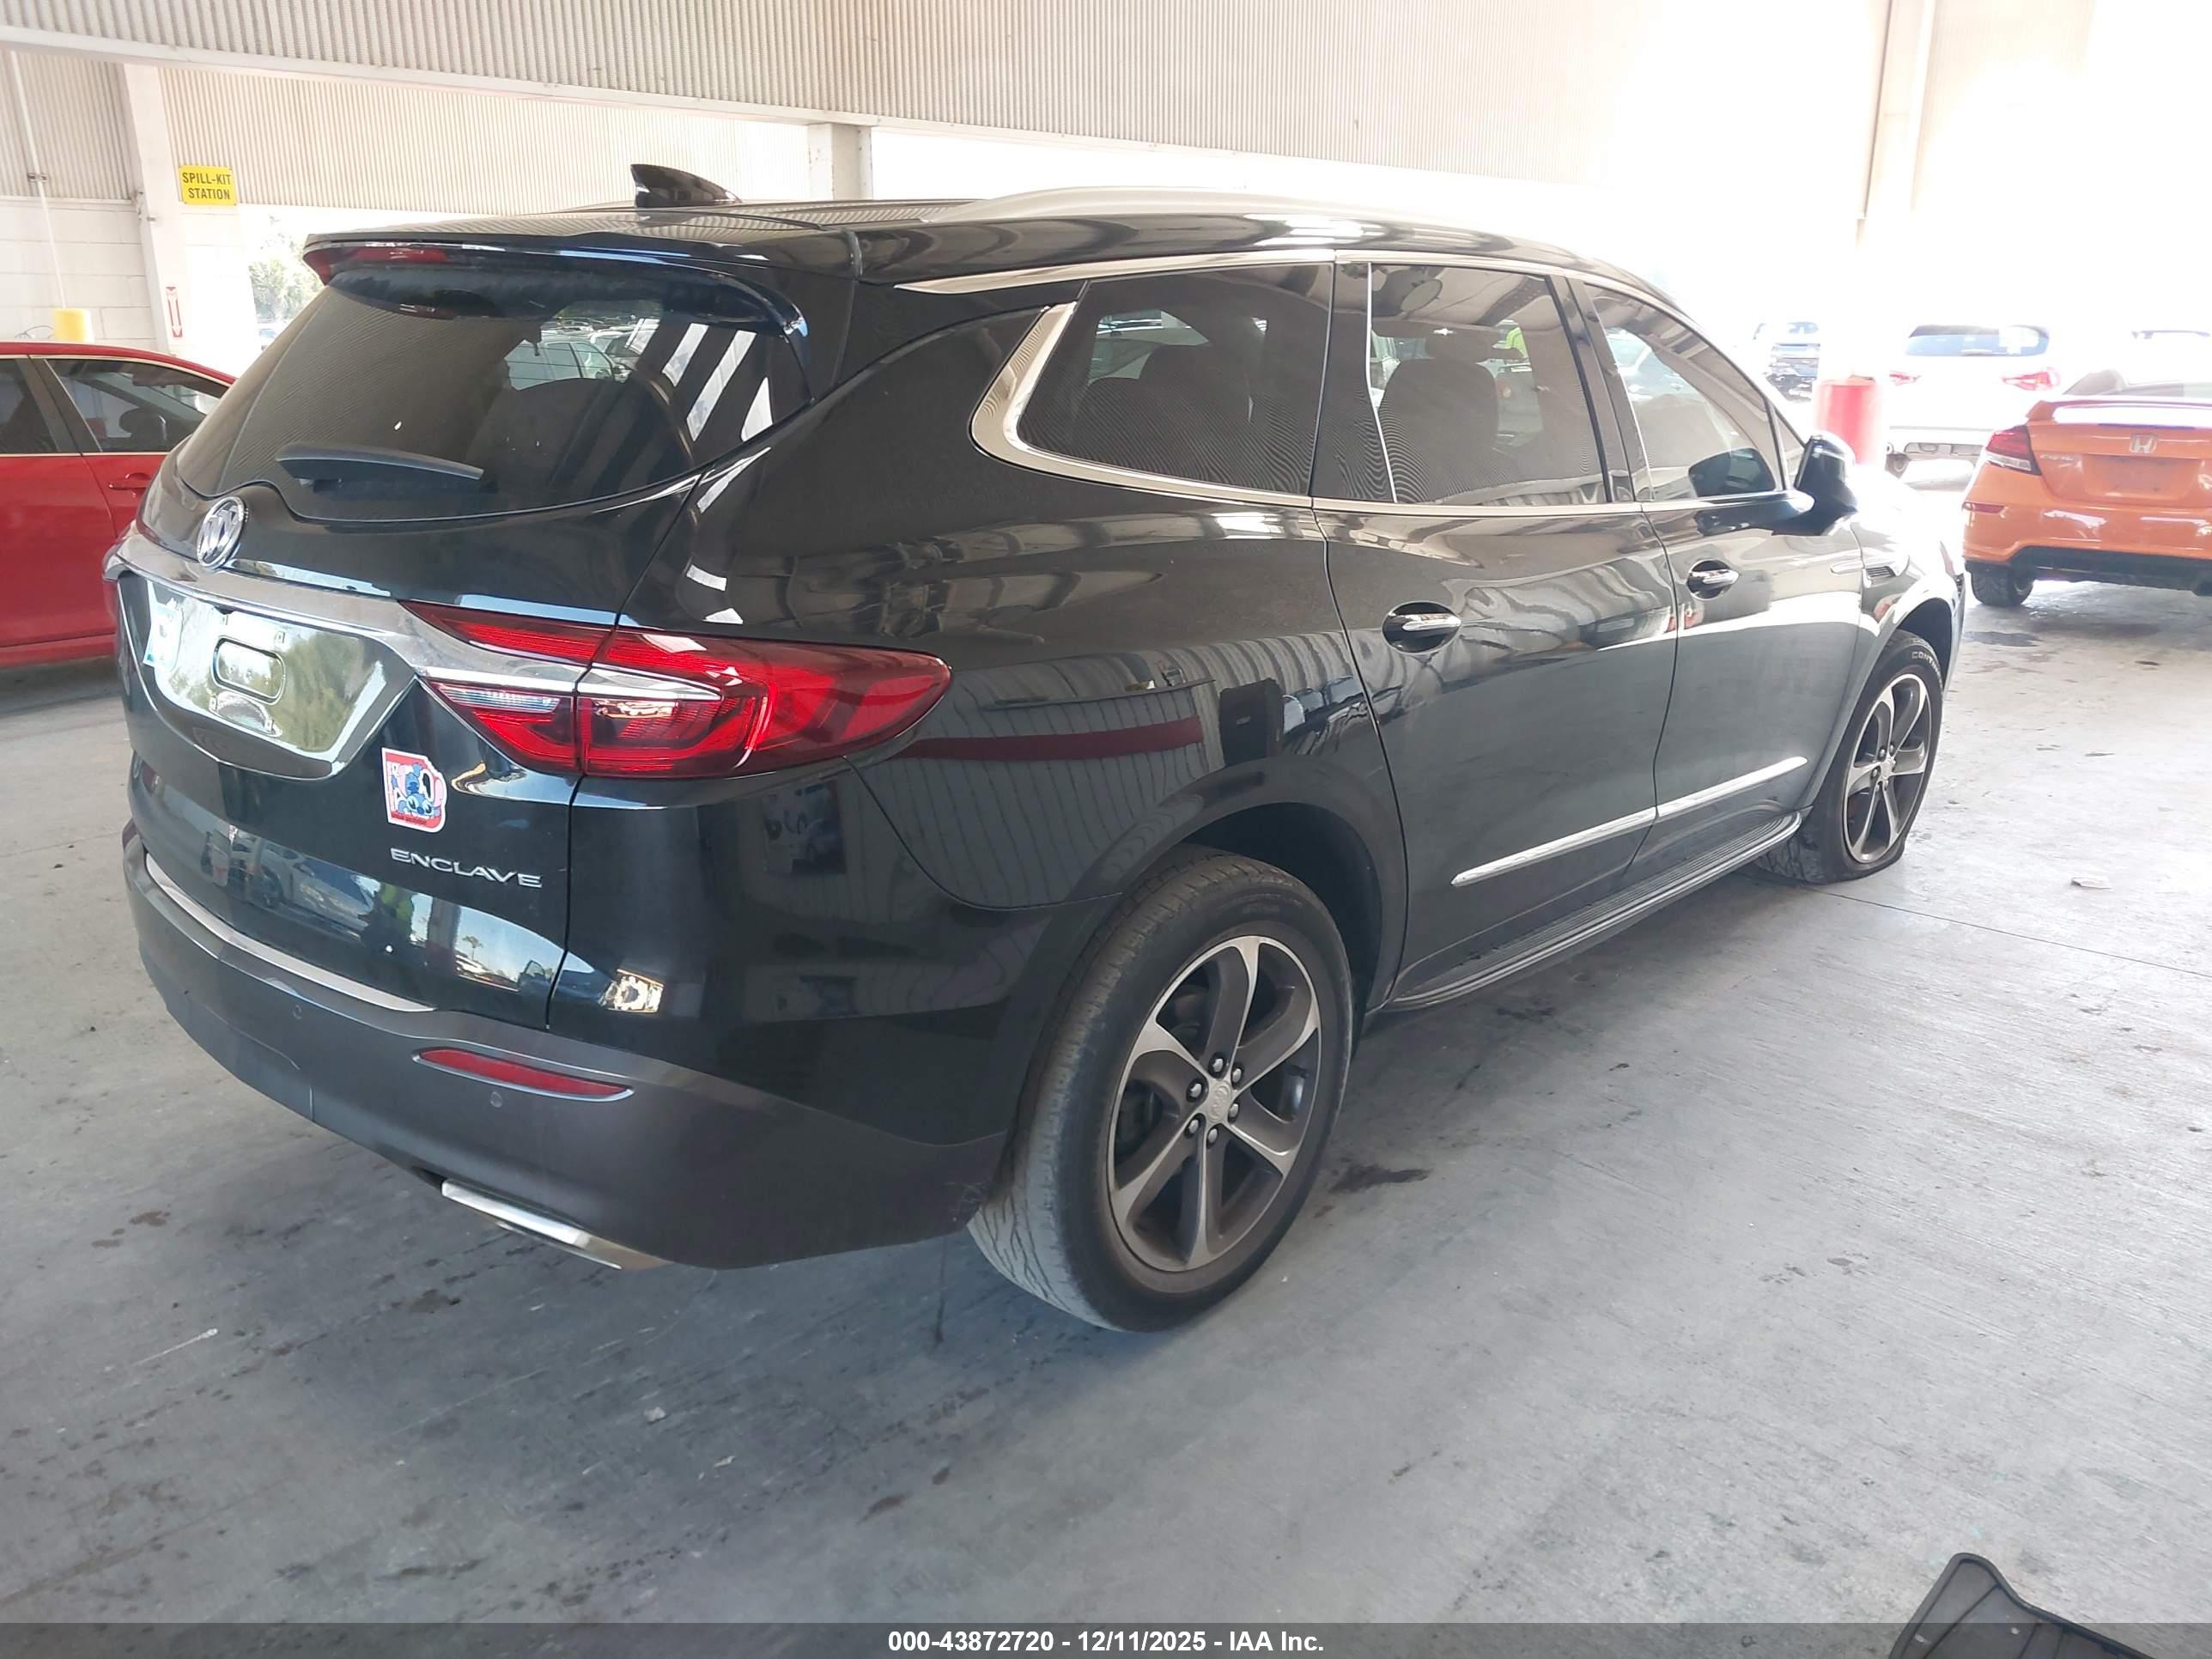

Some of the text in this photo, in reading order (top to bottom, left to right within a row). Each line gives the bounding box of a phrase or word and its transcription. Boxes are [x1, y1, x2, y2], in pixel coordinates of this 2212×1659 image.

[182, 172, 232, 185] SPILL-KIT
[188, 187, 230, 200] STATION
[391, 847, 543, 888] ENCLAVE
